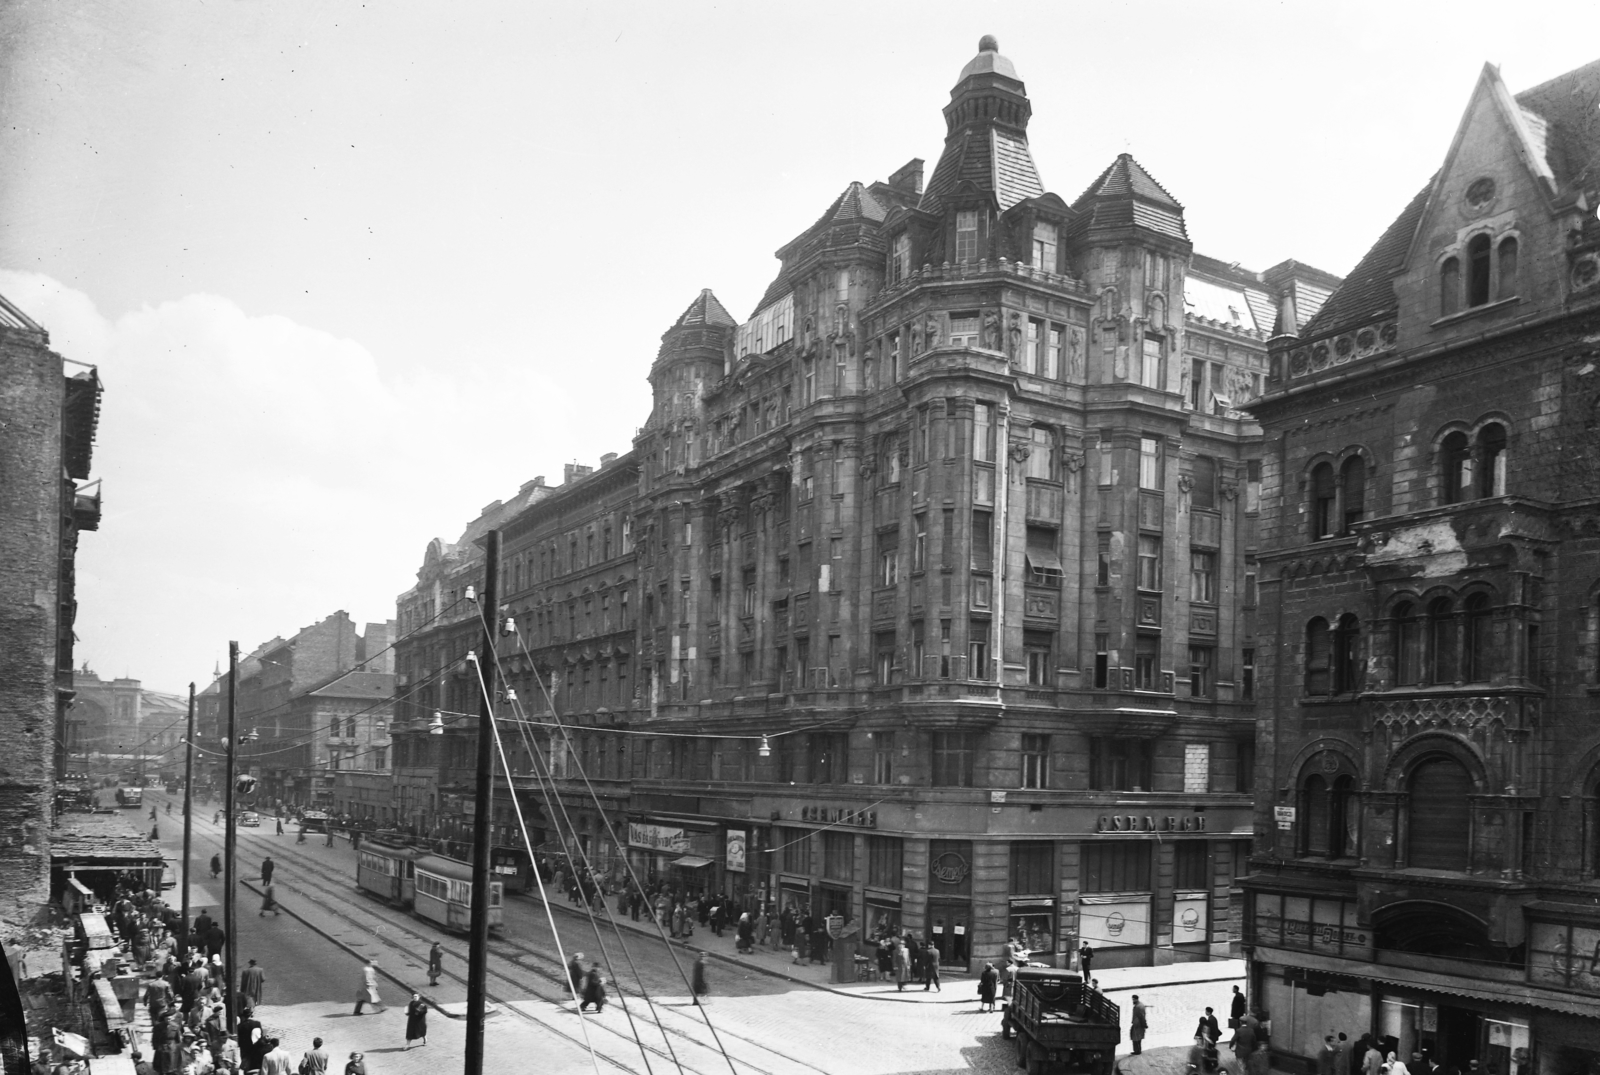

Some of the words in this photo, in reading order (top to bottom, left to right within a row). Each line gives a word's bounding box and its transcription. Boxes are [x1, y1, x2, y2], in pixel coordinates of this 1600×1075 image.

[802, 806, 876, 827] CSEMEGE
[1098, 815, 1206, 831] CSEMEGE
[931, 859, 969, 878] Csemege
